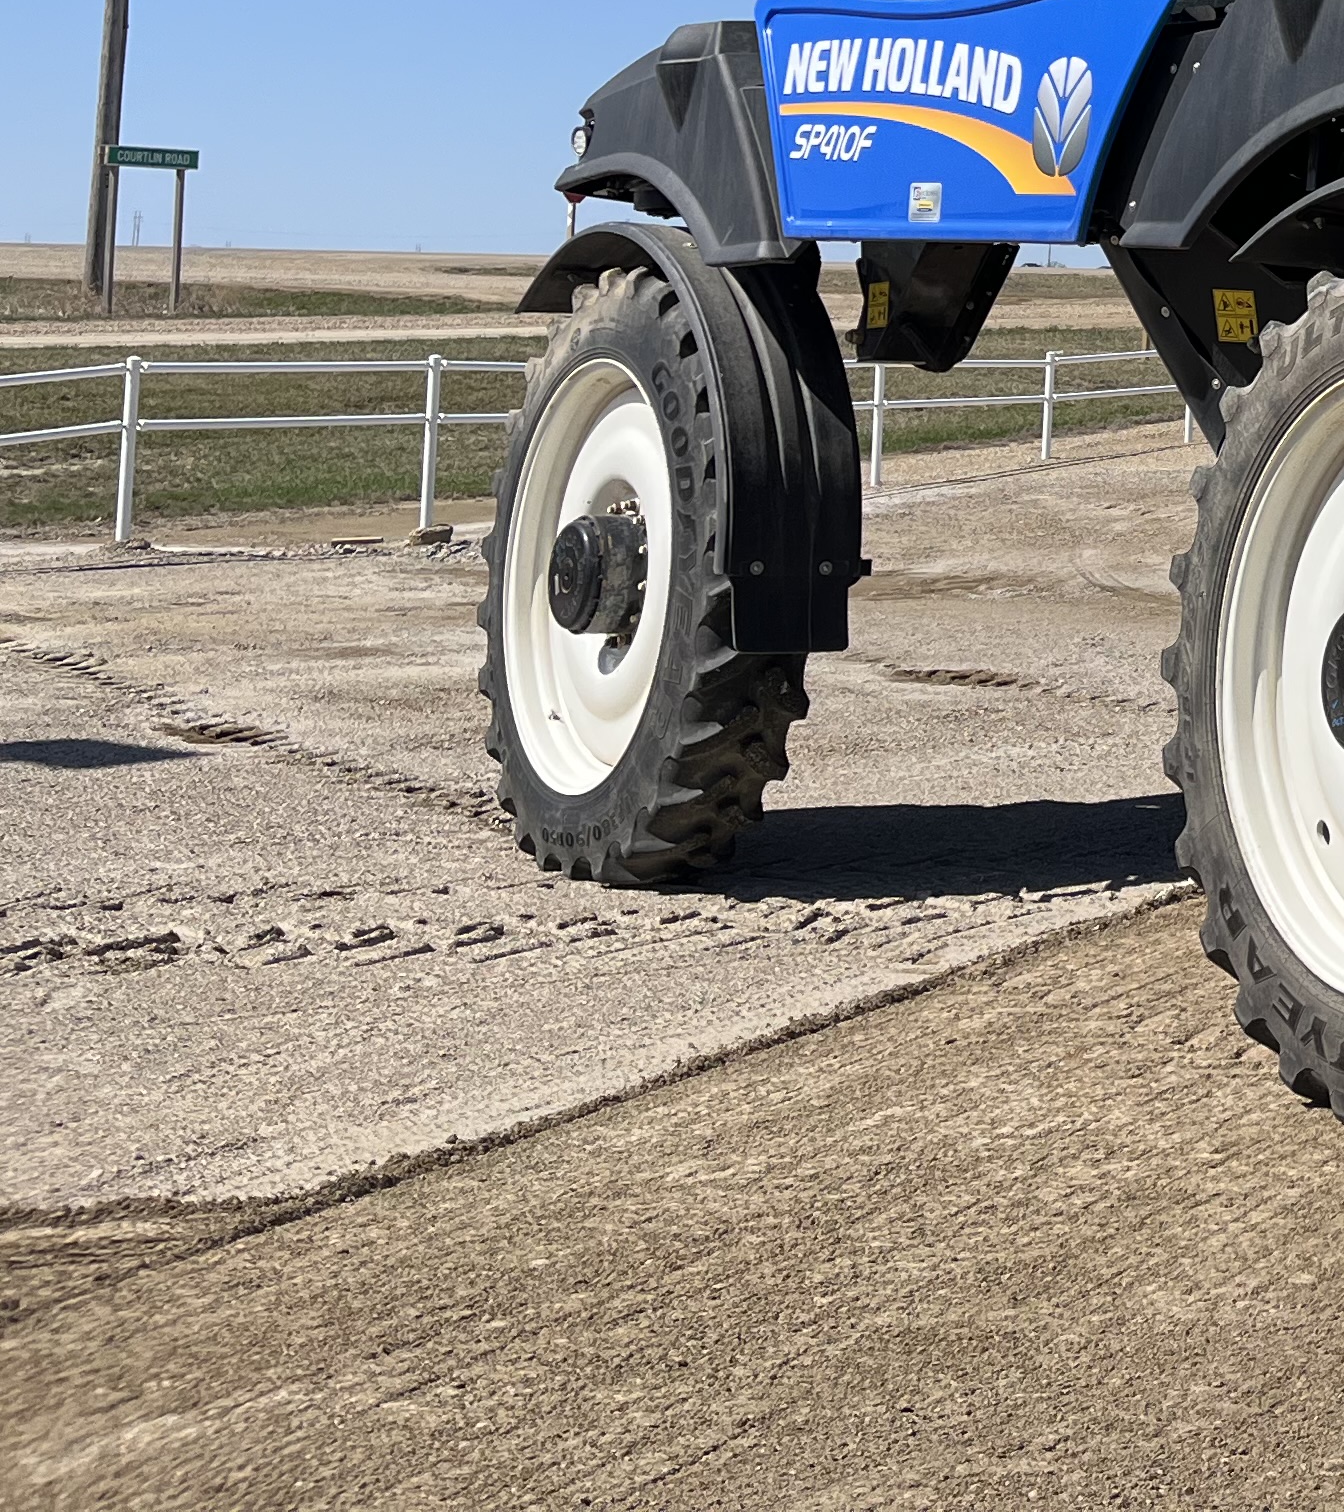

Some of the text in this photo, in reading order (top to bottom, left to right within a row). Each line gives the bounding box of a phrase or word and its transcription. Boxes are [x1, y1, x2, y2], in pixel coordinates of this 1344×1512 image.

[783, 37, 1023, 115] NEW HOLLAND
[165, 153, 190, 165] ROAD
[788, 123, 877, 162] SP410F
